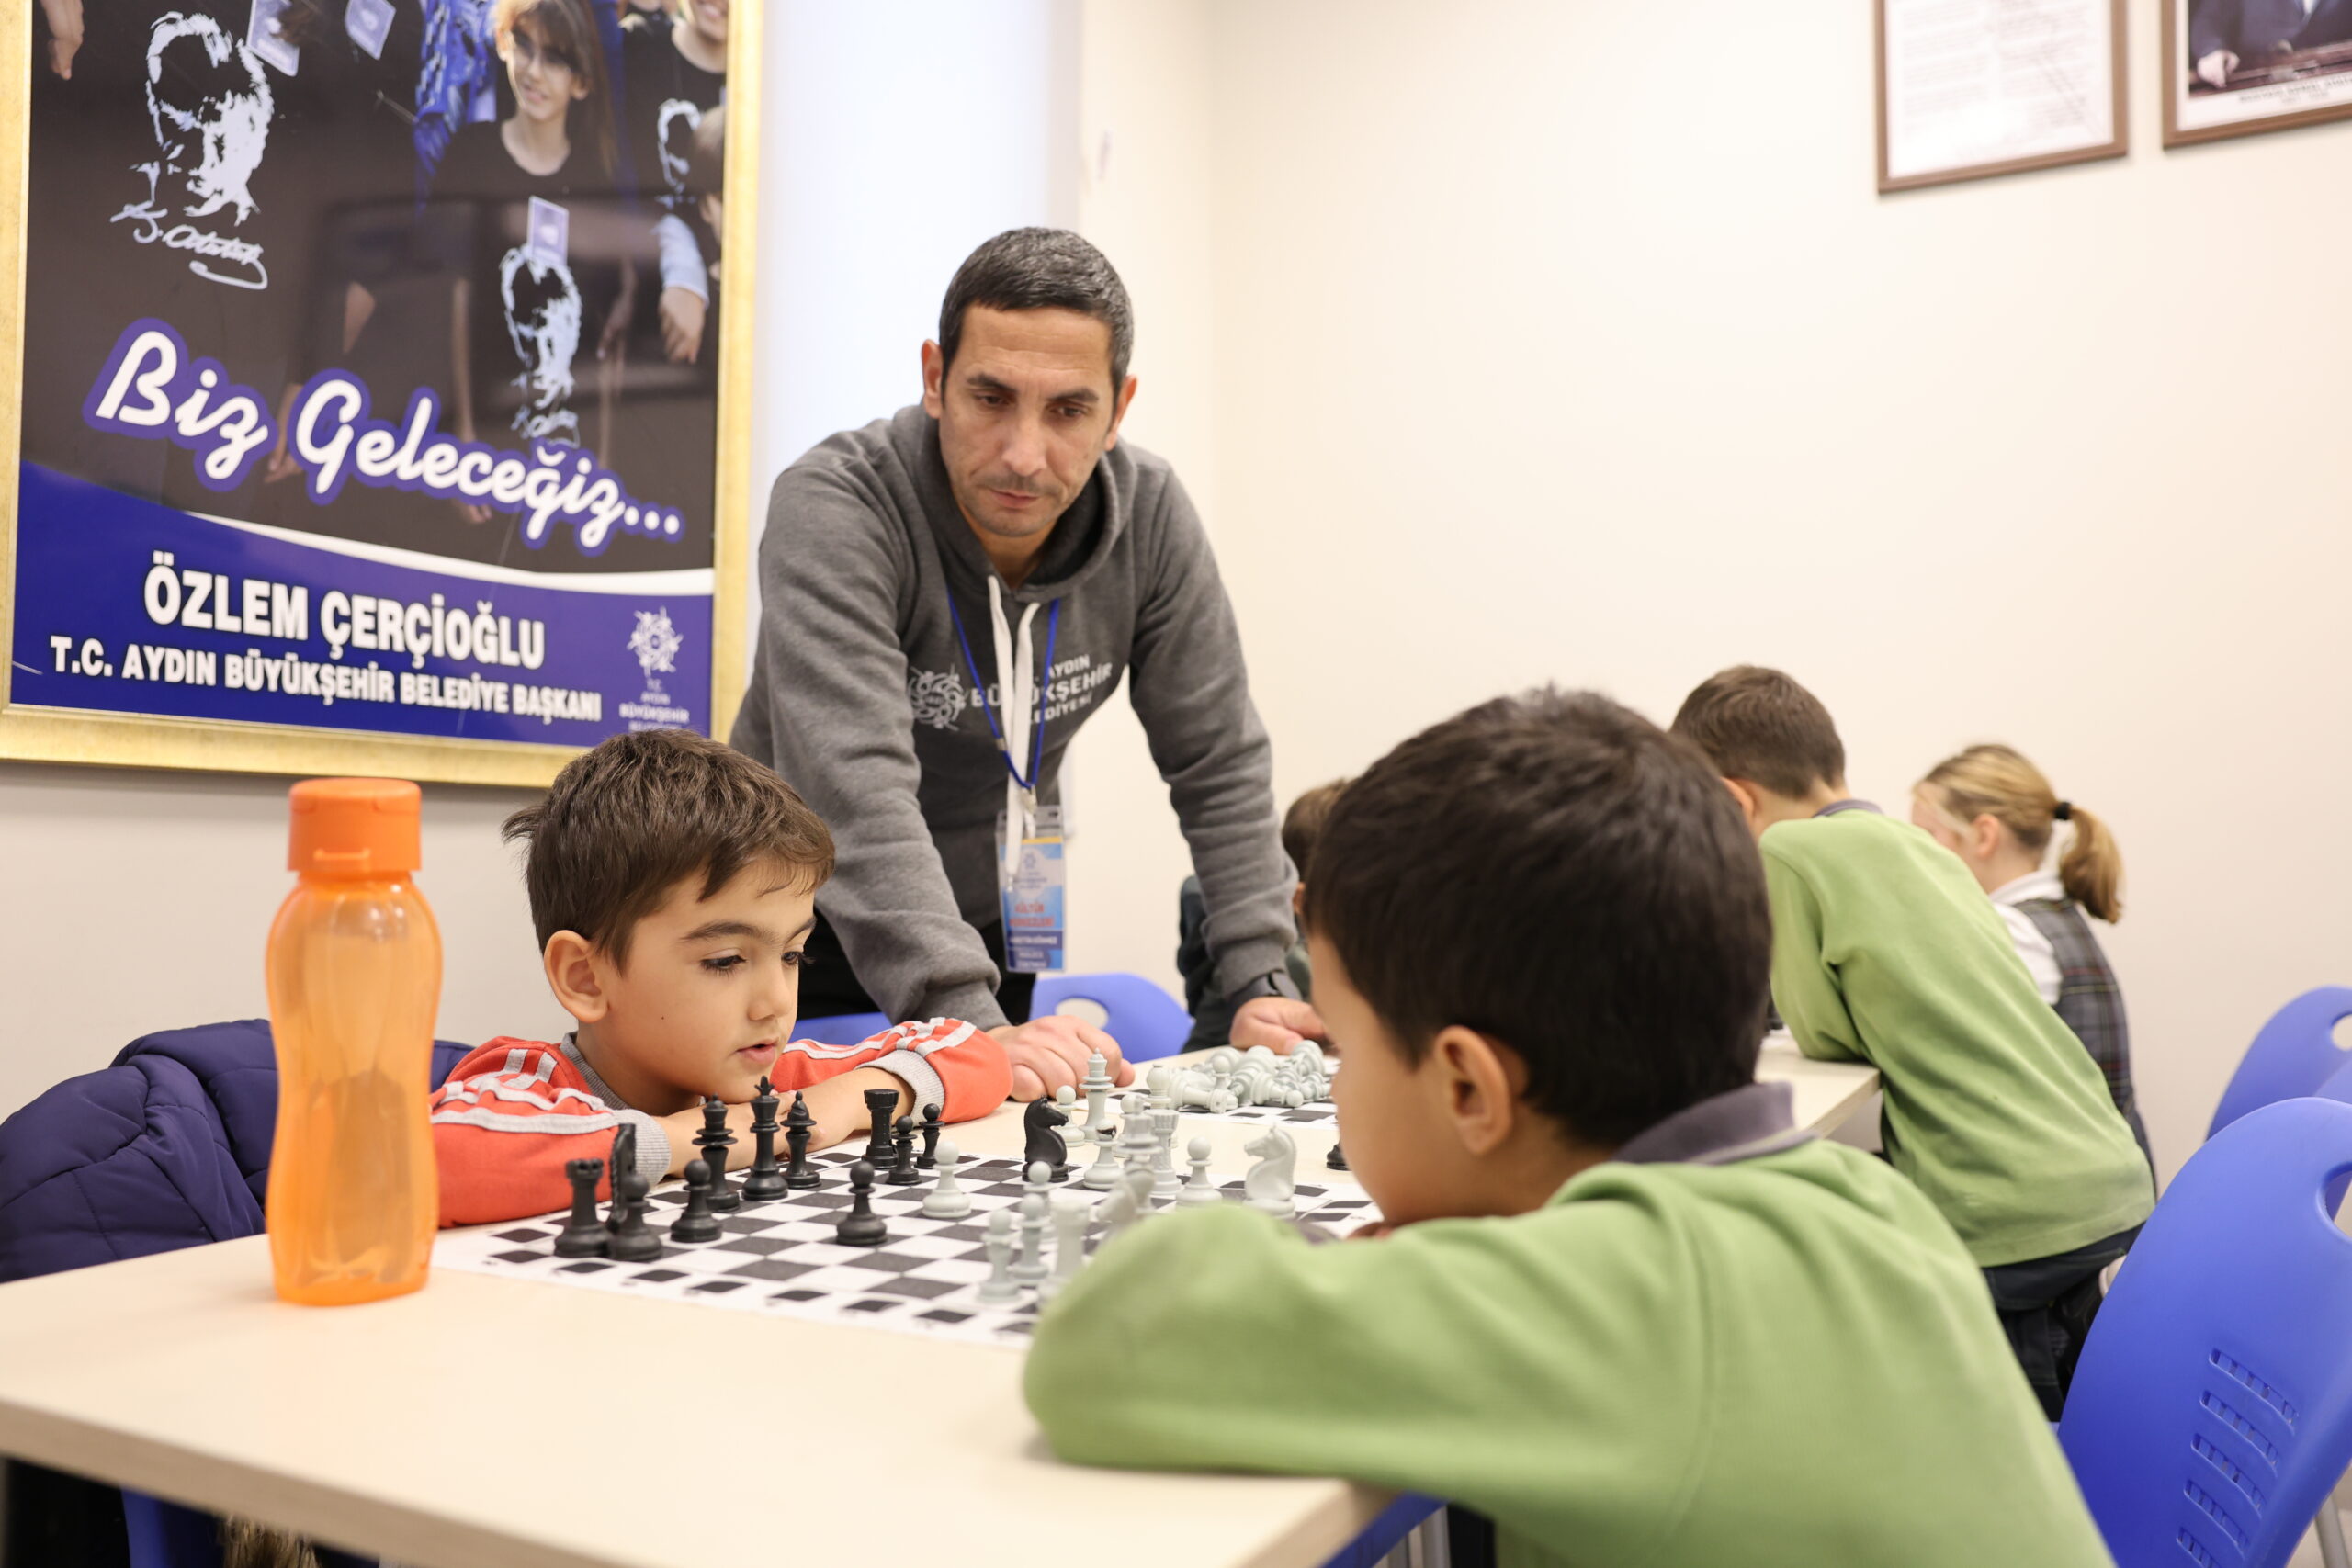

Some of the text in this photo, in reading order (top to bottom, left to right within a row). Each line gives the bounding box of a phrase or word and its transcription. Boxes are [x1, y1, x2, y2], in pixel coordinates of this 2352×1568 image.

[96, 331, 680, 548] Biz Geleceğiz...
[144, 549, 545, 670] ÖZLEM ÇERÇİOĞLU
[50, 635, 602, 725] T.C. AYDIN BÜYÜKŞEHİR BELEDİYE BAŞKANI
